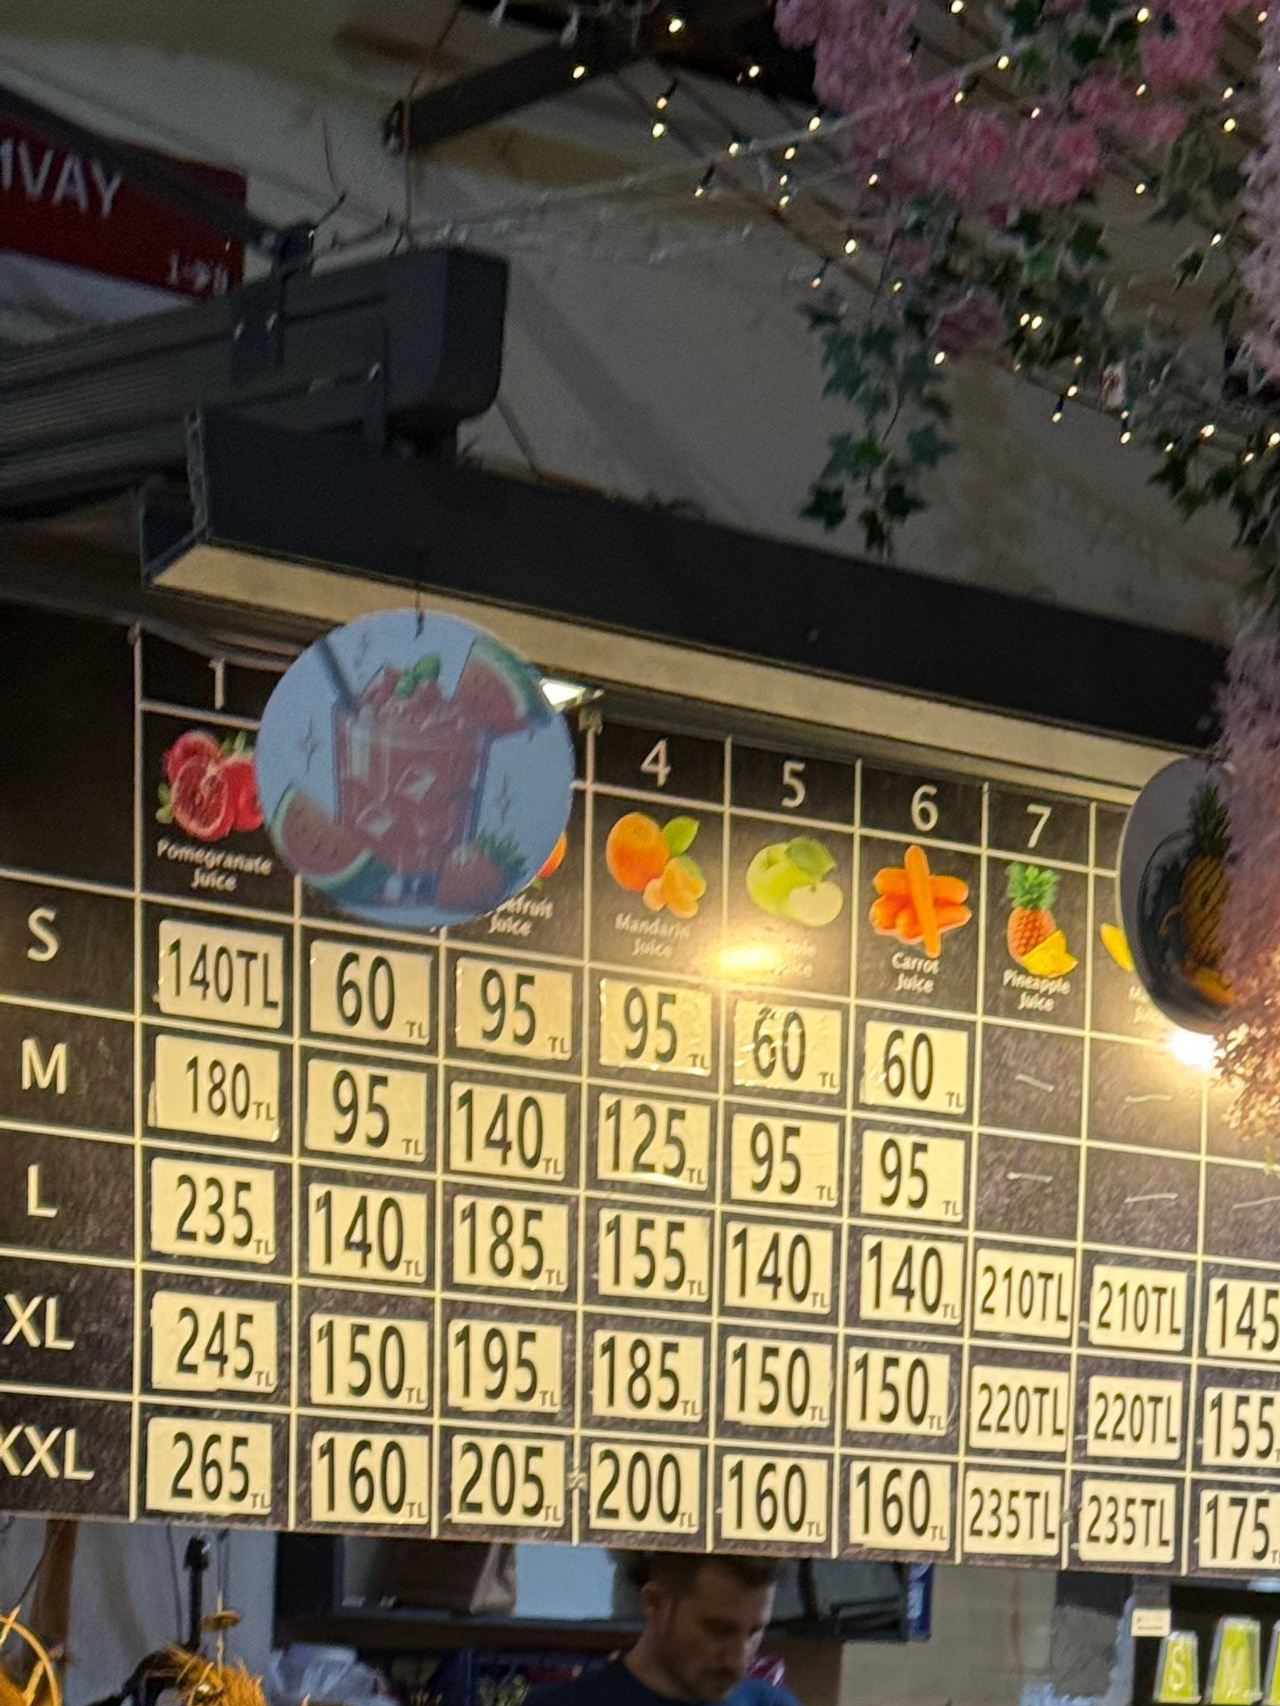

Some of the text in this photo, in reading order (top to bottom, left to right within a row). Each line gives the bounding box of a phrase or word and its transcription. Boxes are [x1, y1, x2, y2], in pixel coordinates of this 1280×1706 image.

[0, 138, 122, 218] VAY
[209, 658, 227, 711] 1
[640, 738, 671, 786] 4
[782, 761, 806, 808] 5
[911, 785, 938, 832] 6
[1025, 804, 1052, 848] 7
[157, 838, 273, 876] Pomegranate
[190, 867, 237, 892] Juice
[27, 908, 57, 962] S
[488, 911, 532, 937] Juice
[615, 912, 691, 940] Mandarin
[631, 937, 674, 959] Juice
[168, 938, 278, 1009] 140TL
[337, 952, 428, 1039] 60 TL
[891, 951, 940, 975] Carrot
[895, 971, 935, 994] Juice
[1002, 968, 1071, 996] Pineapple
[481, 968, 569, 1054] 95 TL
[624, 987, 709, 1071] 95 TL
[1017, 991, 1055, 1012] Juice
[21, 1038, 67, 1094] M
[753, 1006, 838, 1089] 60 TL
[884, 1030, 964, 1108] 60 TL
[187, 1056, 275, 1120] 180 TL
[333, 1069, 424, 1156] 95 TL
[457, 1088, 563, 1174] 140 TL
[605, 1099, 706, 1185] 125 TL
[751, 1122, 836, 1202] 95 TL
[27, 1164, 58, 1218] L
[881, 1138, 960, 1216] 95 TL
[177, 1174, 275, 1255] 235 TL
[316, 1189, 424, 1277] 140 TL
[461, 1201, 565, 1286] 185 TL
[606, 1214, 707, 1296] 155 TL
[733, 1228, 829, 1308] 140 TL
[869, 1242, 960, 1320] 140 TL
[3, 1293, 75, 1350] XL
[982, 1265, 1068, 1322] 210TL
[1098, 1281, 1181, 1335] 210TL
[1215, 1283, 1279, 1352] 145
[177, 1306, 275, 1387] 245 TL
[317, 1319, 426, 1404] 150 TL
[454, 1323, 558, 1406] 195 TL
[600, 1336, 700, 1417] 185 TL
[732, 1343, 828, 1422] 150 TL
[855, 1352, 945, 1430] 150 TL
[978, 1383, 1064, 1436] 220TL
[1094, 1392, 1177, 1443] 220TL
[1210, 1392, 1274, 1458] 155
[171, 1431, 272, 1509] 265 TL
[319, 1437, 427, 1519] 160 TL
[459, 1442, 564, 1521] 205 TL
[598, 1449, 696, 1528] 200 TL
[729, 1461, 825, 1538] 160 TL
[857, 1466, 946, 1541] 160 TL
[970, 1488, 1055, 1540] 235TL
[1087, 1495, 1170, 1547] 235TL
[1206, 1494, 1270, 1560] 175
[1168, 1643, 1187, 1693] S
